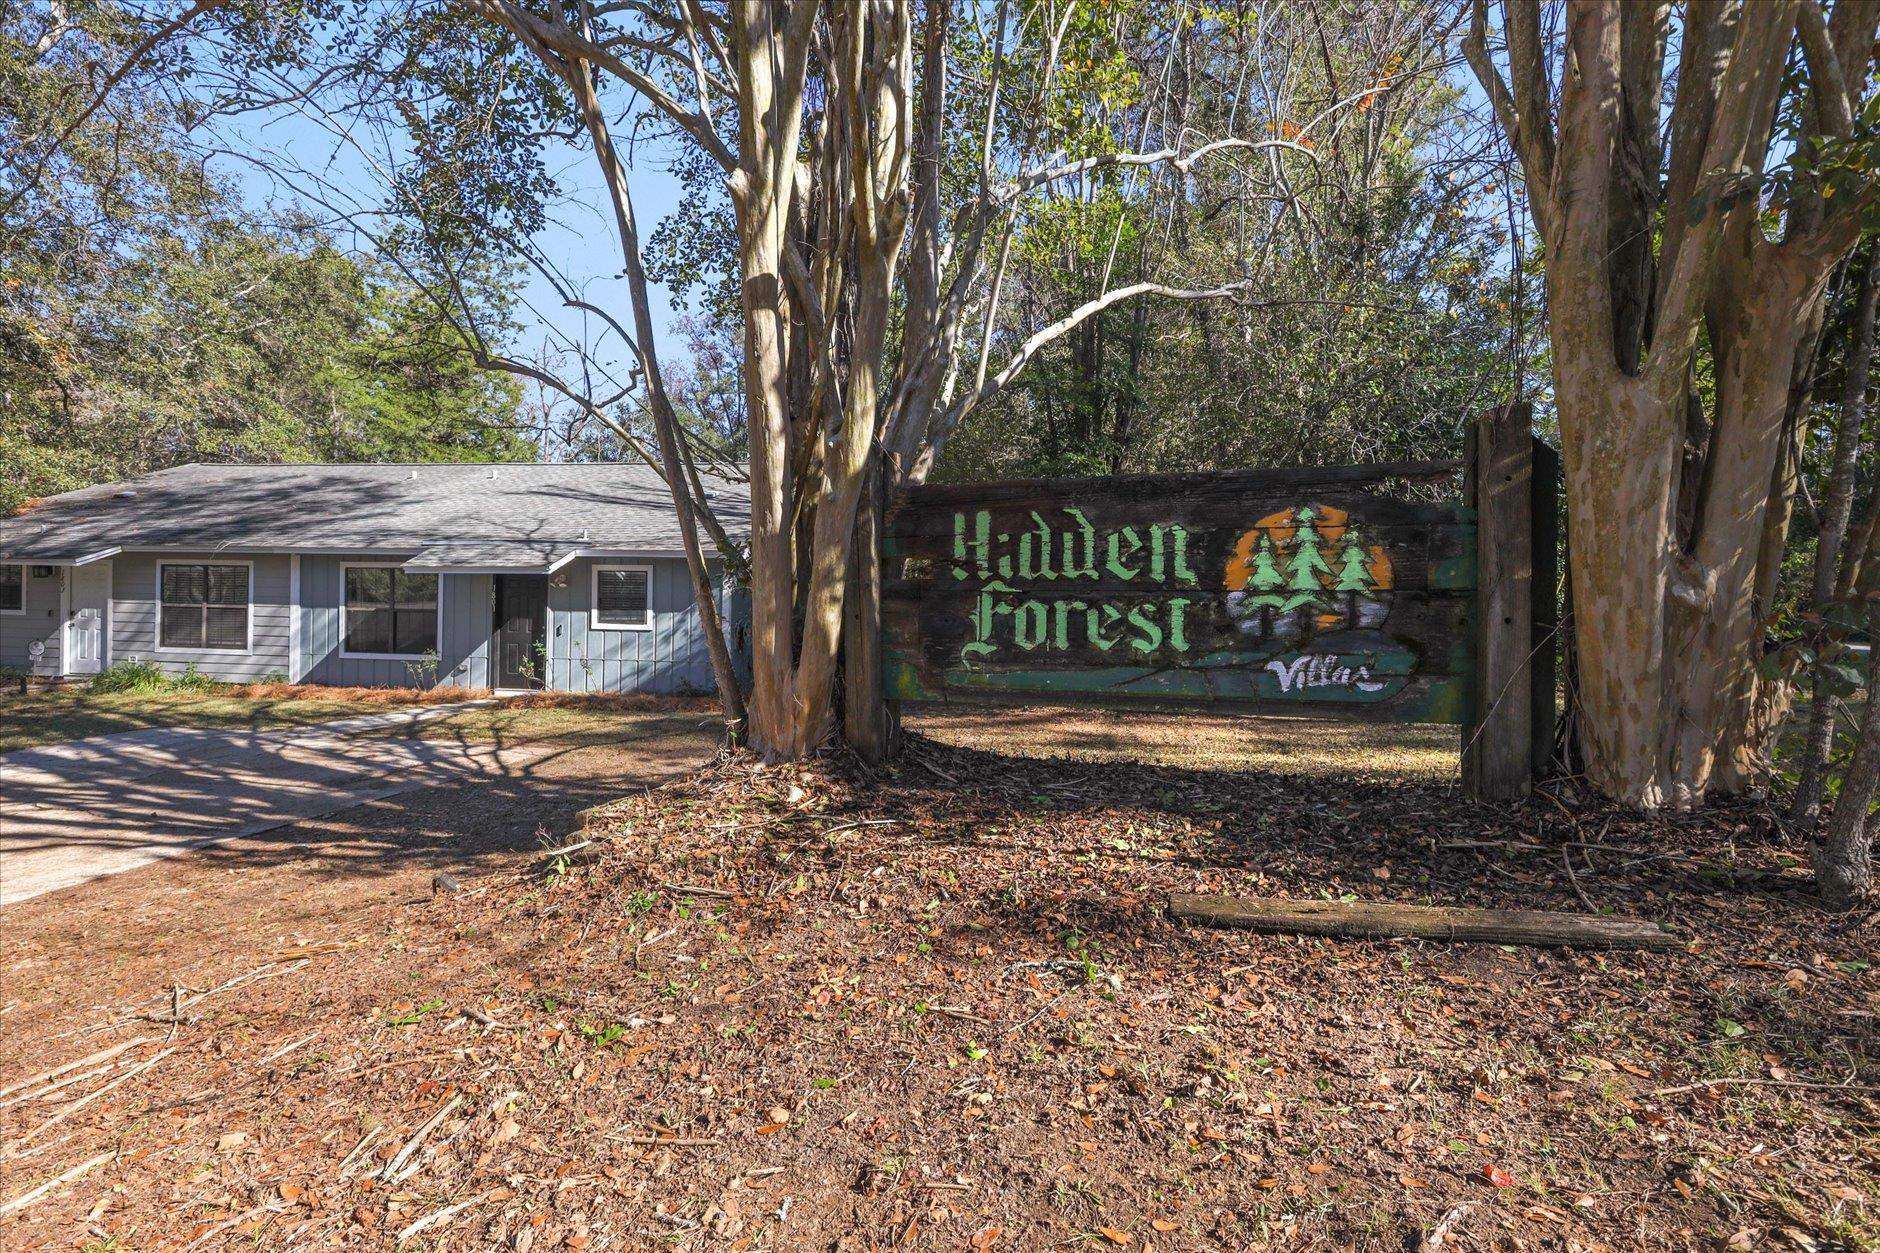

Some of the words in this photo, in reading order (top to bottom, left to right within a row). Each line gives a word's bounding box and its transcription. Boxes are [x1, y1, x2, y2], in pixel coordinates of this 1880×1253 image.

[952, 507, 1198, 585] Hidden
[961, 581, 1191, 671] Forest
[1264, 653, 1389, 693] Villas
